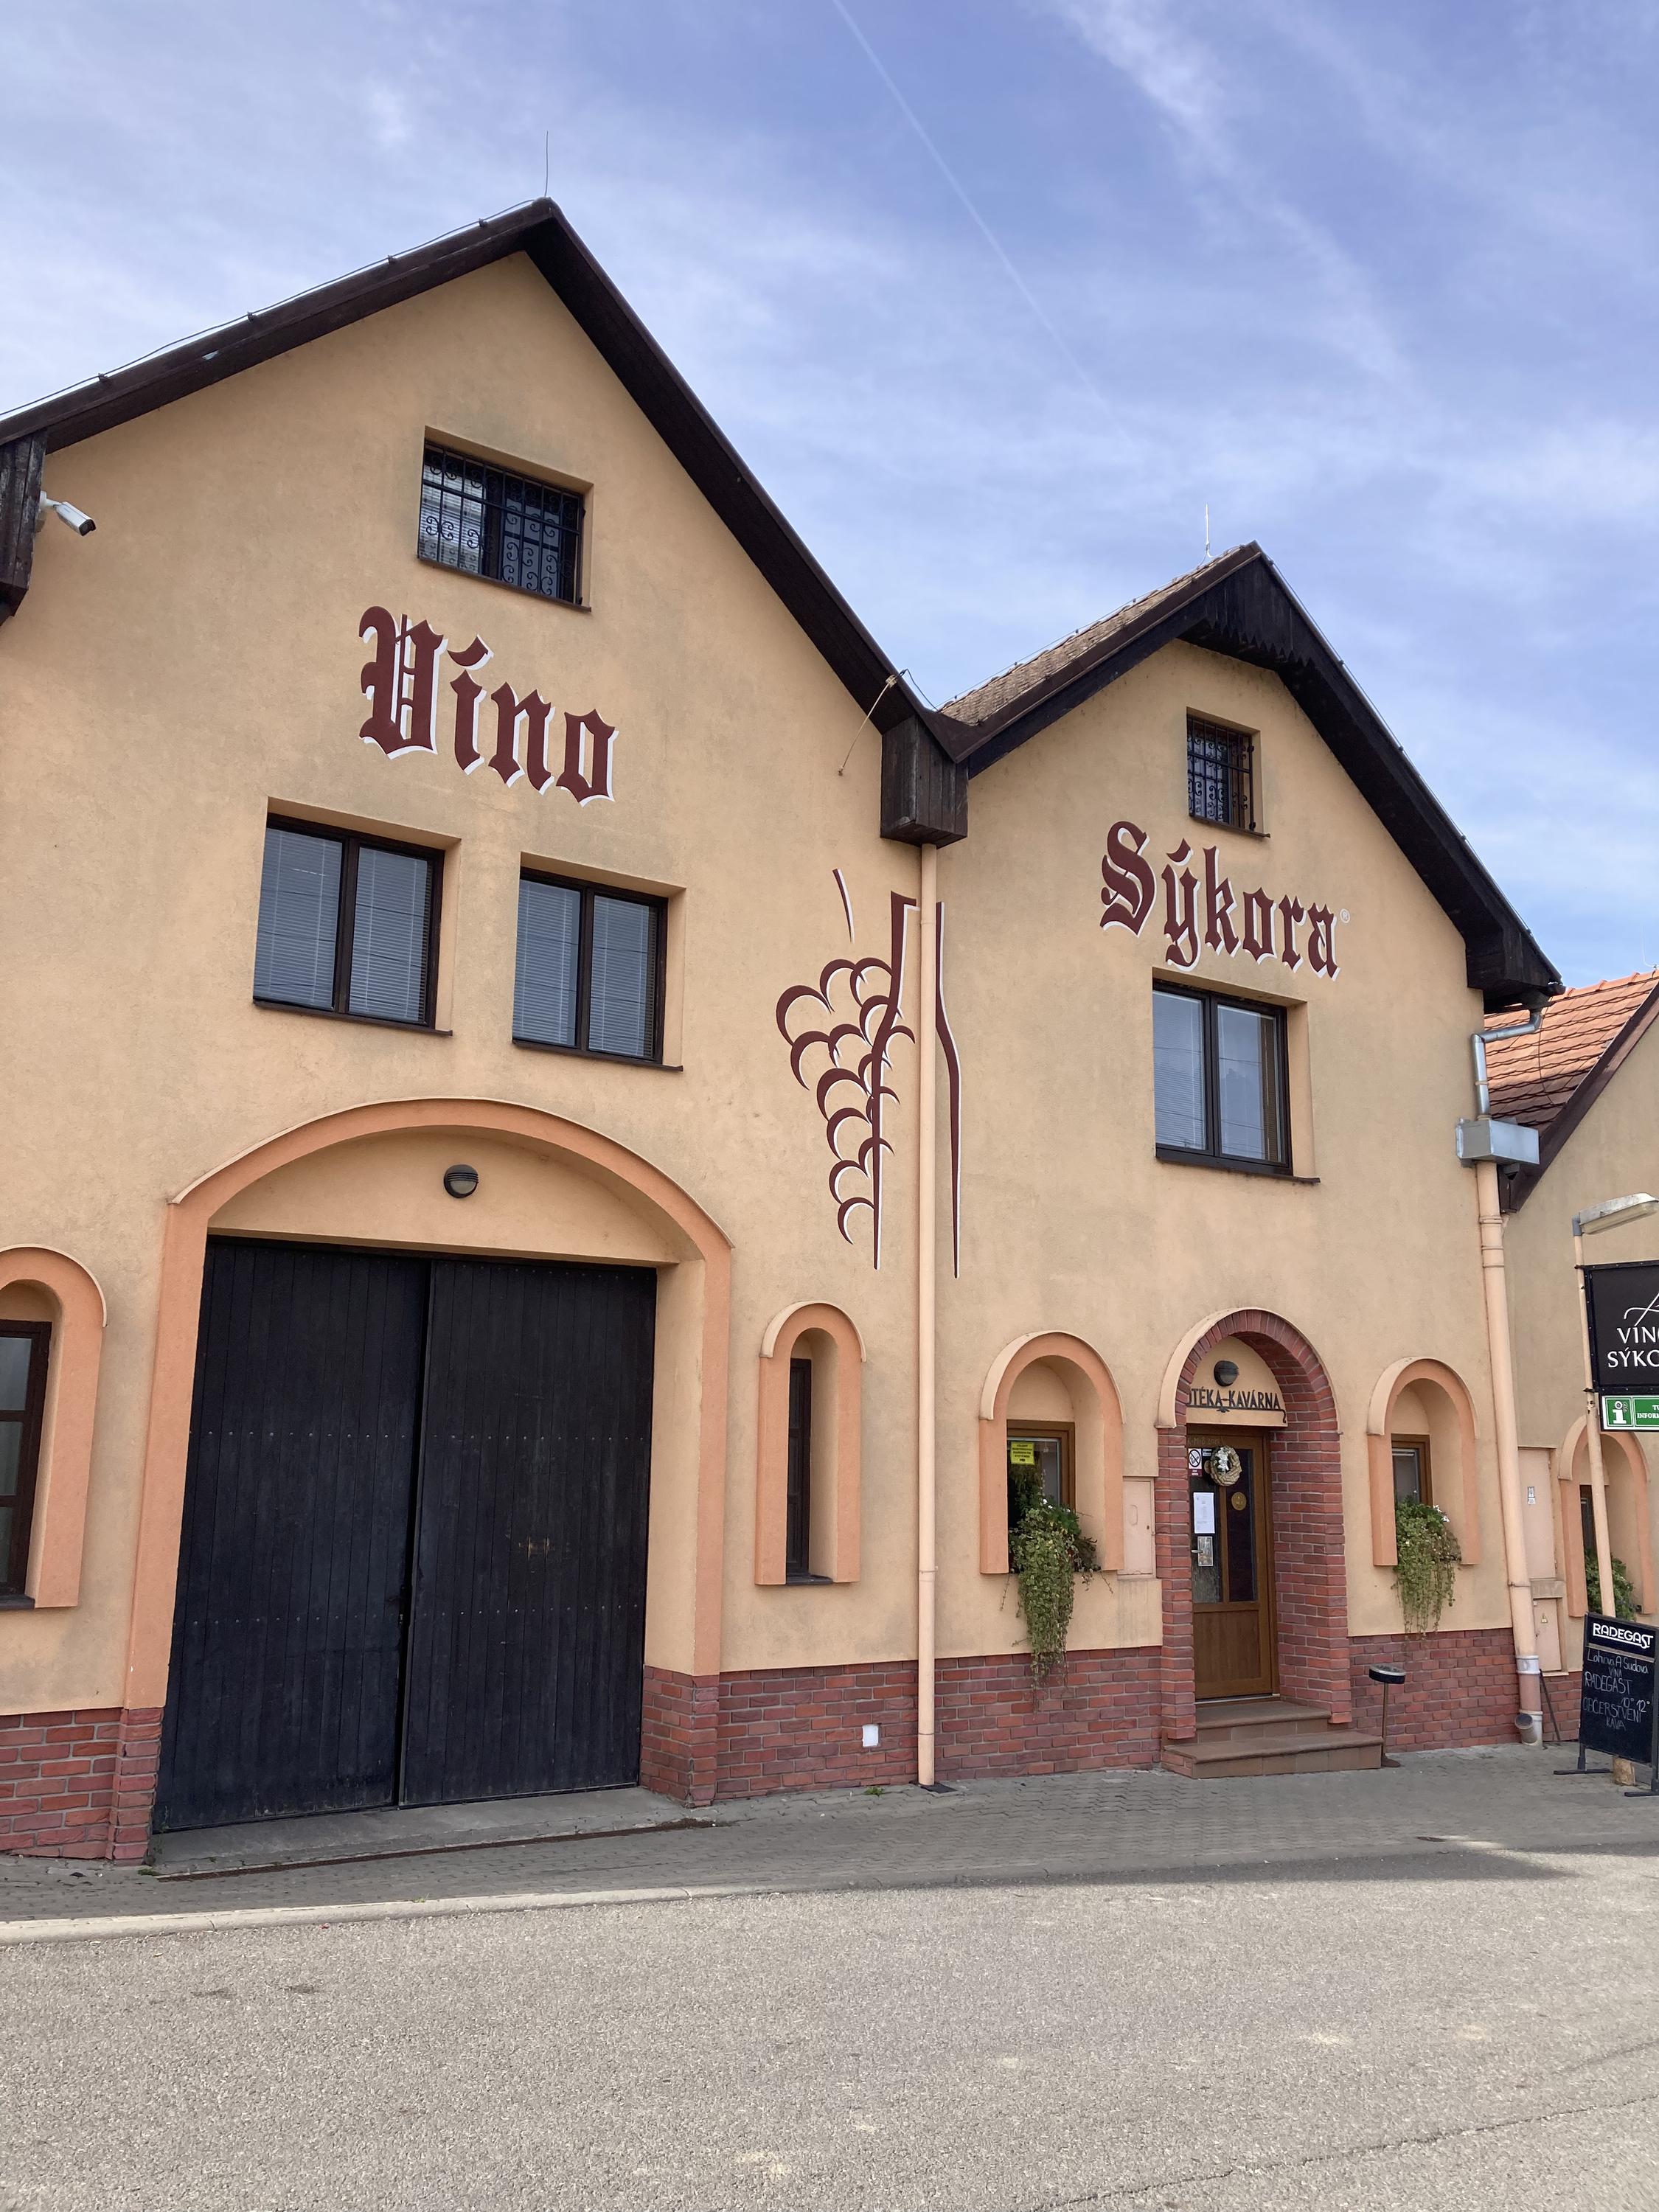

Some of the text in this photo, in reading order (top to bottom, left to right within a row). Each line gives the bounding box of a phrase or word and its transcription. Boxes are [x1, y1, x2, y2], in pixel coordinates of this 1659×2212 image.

[1616, 1325, 1659, 1344] VÍN
[1593, 1623, 1654, 1649] RADEGAST
[1585, 1671, 1633, 1695] RADEGAST
